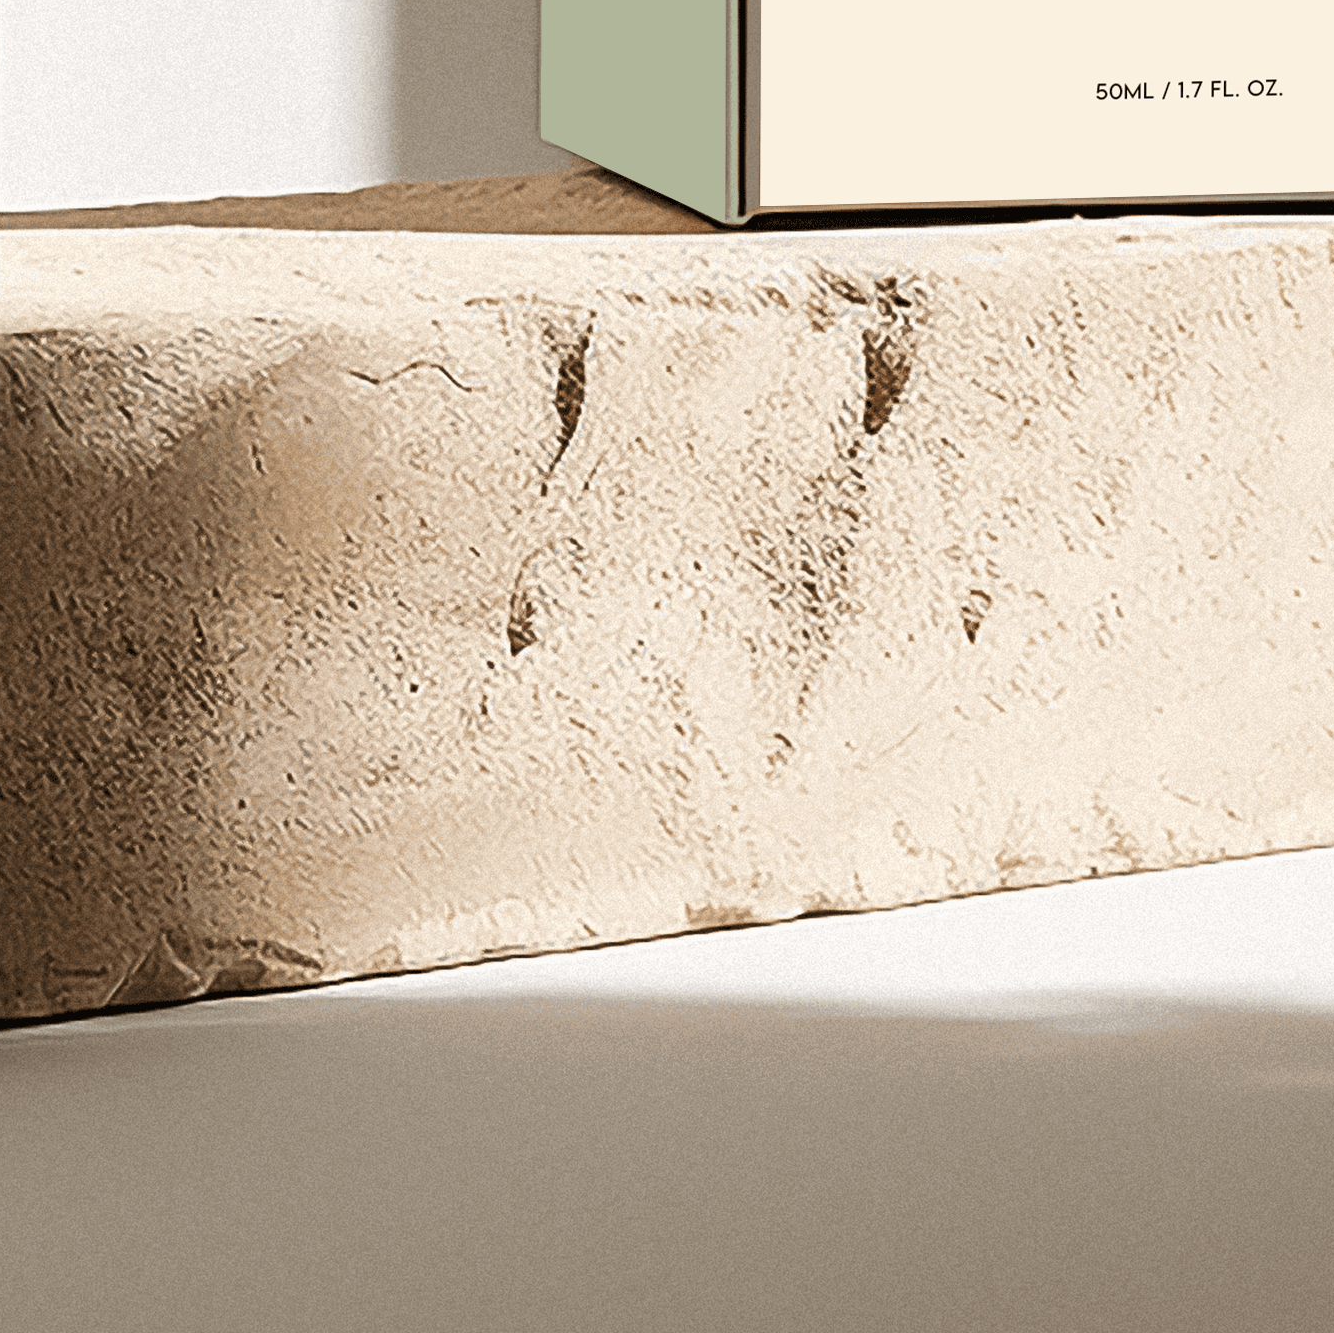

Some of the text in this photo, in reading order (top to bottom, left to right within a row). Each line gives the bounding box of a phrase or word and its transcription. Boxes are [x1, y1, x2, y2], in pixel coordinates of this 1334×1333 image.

[1095, 79, 1283, 101] 50ML / 1.7 FL. OZ.
